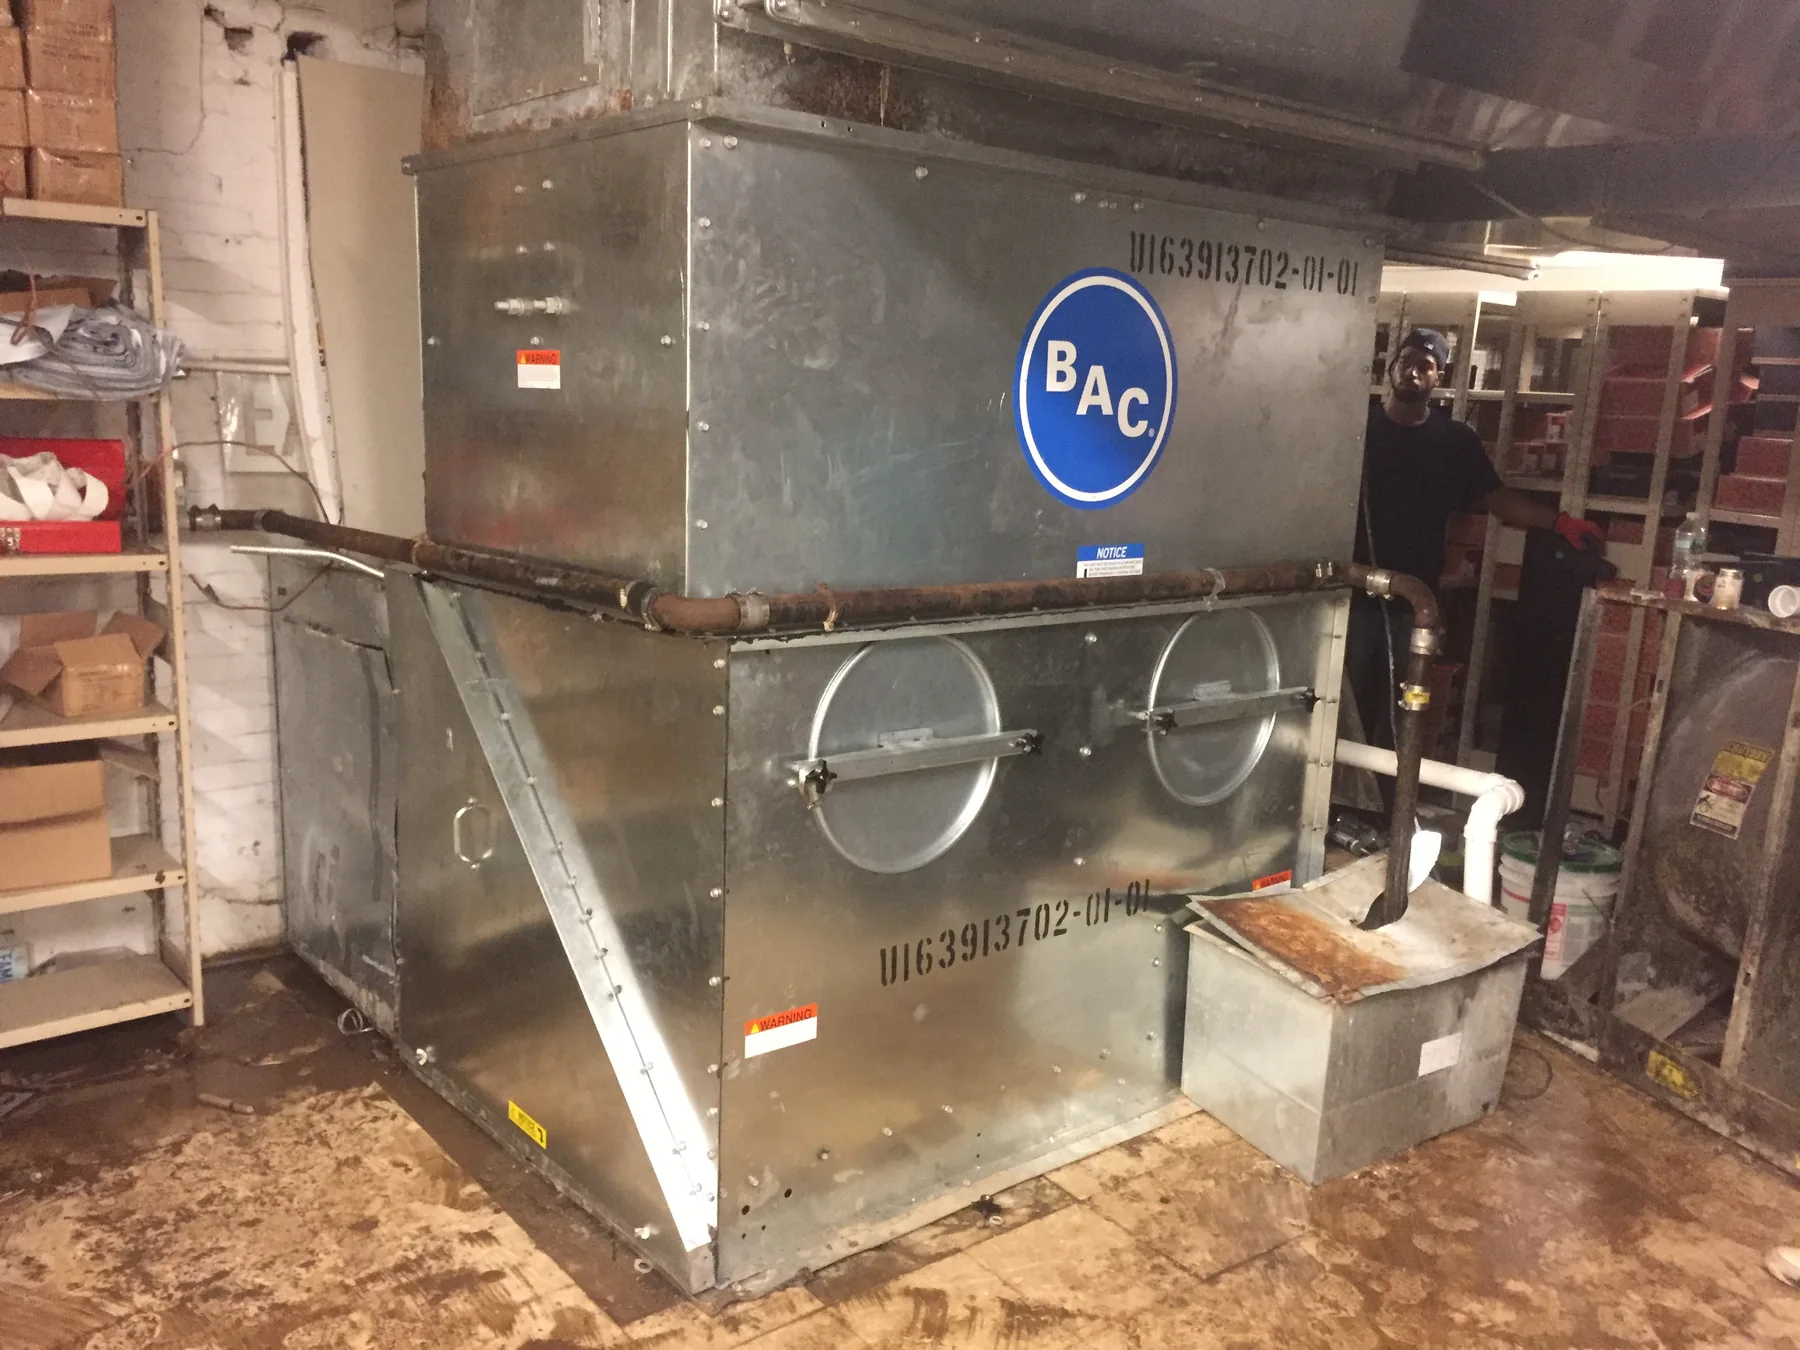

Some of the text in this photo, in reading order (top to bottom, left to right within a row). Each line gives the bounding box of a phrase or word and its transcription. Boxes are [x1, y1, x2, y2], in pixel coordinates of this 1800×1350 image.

[1131, 230, 1358, 296] U163913702-01-01
[1045, 340, 1149, 438] BAC
[1096, 546, 1128, 560] NOTICE
[879, 879, 1151, 987] U163913702-01-01
[760, 1008, 812, 1032] WARNING
